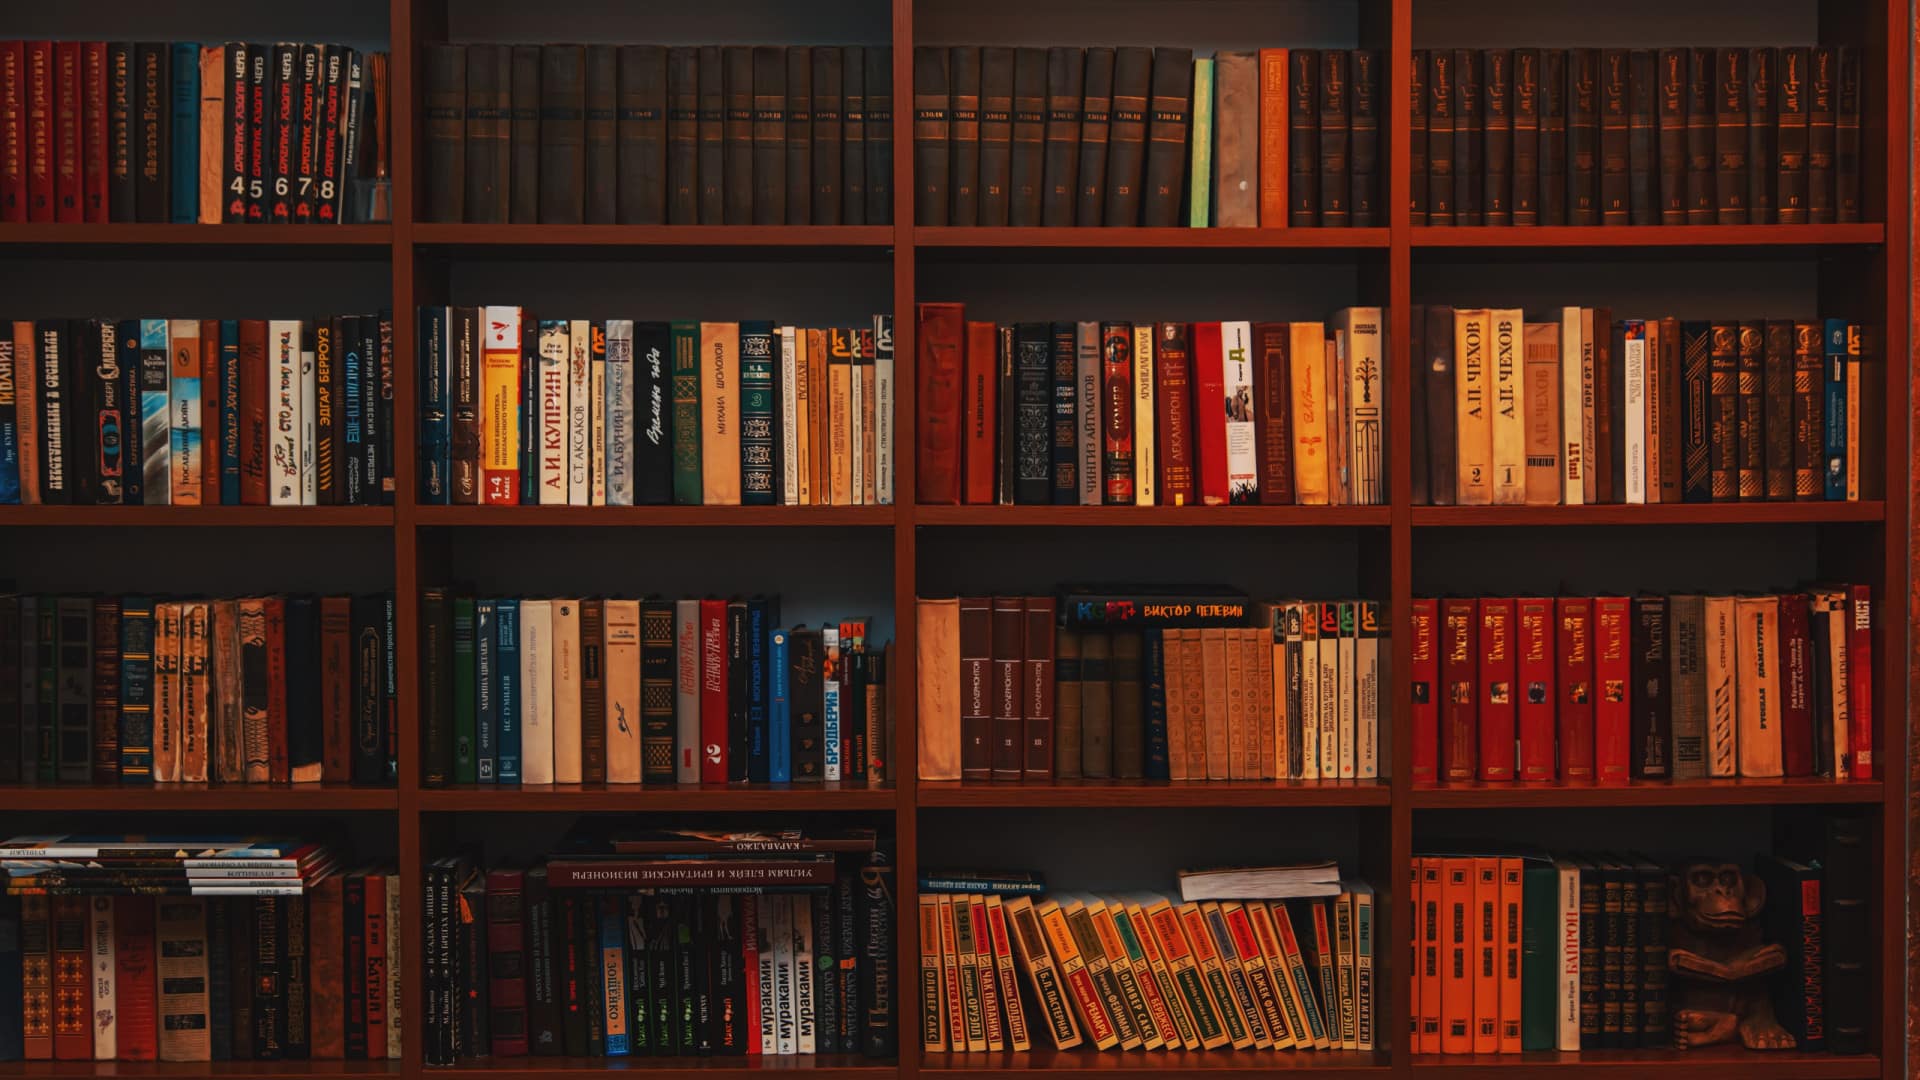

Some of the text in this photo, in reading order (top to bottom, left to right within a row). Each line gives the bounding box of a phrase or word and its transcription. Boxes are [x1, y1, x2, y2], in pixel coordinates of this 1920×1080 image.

[231, 176, 246, 196] 4
[250, 179, 264, 199] 5
[275, 176, 289, 197] 6
[298, 176, 313, 196] 7
[320, 180, 335, 200] 8
[380, 321, 393, 399] СУМЕРКИ
[1466, 321, 1481, 382] ЧЕХОВ
[1498, 321, 1513, 382] ЧЕХОВ
[105, 382, 115, 407] РОБЕРТ
[318, 327, 331, 426] ЭДГАР БЕРРОУЗ
[714, 342, 726, 434] МИХАИЛ ШОЛОХОВ
[752, 393, 762, 407] 3
[1535, 369, 1548, 417] ЧЕХОВ
[545, 371, 560, 449] КУПРИН
[574, 405, 584, 460] АКСАКОВ
[1084, 374, 1096, 493] ЧИНГИЗ АЙТМАТОВ
[1170, 391, 1183, 461] ДЕКАМЕРОН
[47, 402, 63, 490] ПРЕСТУПЛЕНИЕ
[491, 477, 502, 500] 1-4
[1472, 468, 1481, 483] 2
[1506, 468, 1512, 483] 1
[1143, 604, 1243, 619] ВИКТОР ПЕЛЕВИН
[1856, 599, 1870, 630] ТЕКСТ
[826, 691, 838, 765] БРЭДБЕРИ
[736, 841, 801, 851] КАРАВАДЖО
[958, 909, 970, 941] 1984
[1339, 909, 1349, 941] 1984
[1360, 921, 1368, 940] МЫ
[1565, 912, 1578, 975] БАЙРОН
[607, 963, 618, 1020] ЗОЩЕНКО
[761, 960, 775, 1035] мураками
[778, 964, 793, 1039] мураками
[795, 961, 812, 1036] мураками
[926, 971, 937, 1040] ОЛИВЕР САКС
[980, 969, 996, 1038] ЧАК ПАЛАНИК
[1046, 990, 1065, 1037] ПАСТЕРНАК
[1121, 973, 1154, 1037] ОЛИВЕР САКС
[1250, 973, 1285, 1038] ДЖЕК ФИННЕЙ
[1360, 990, 1369, 1040] ЗАМЯТИН
[636, 998, 647, 1047] Макс Фрай
[683, 998, 693, 1047] Макс Фрай
[723, 998, 735, 1047] Макс Фрай
[968, 998, 982, 1036] ОРУЭЛЛ
[1009, 998, 1024, 1039] ГОЛДИНГ
[1087, 1002, 1107, 1038] РЕМАРК
[1108, 994, 1131, 1038] ФЕЙНМАН
[1150, 997, 1173, 1038] БЕРДЖЕСС
[1247, 1007, 1265, 1036] ПРИСТ
[1343, 998, 1353, 1036] ОРУЭЛЛ
